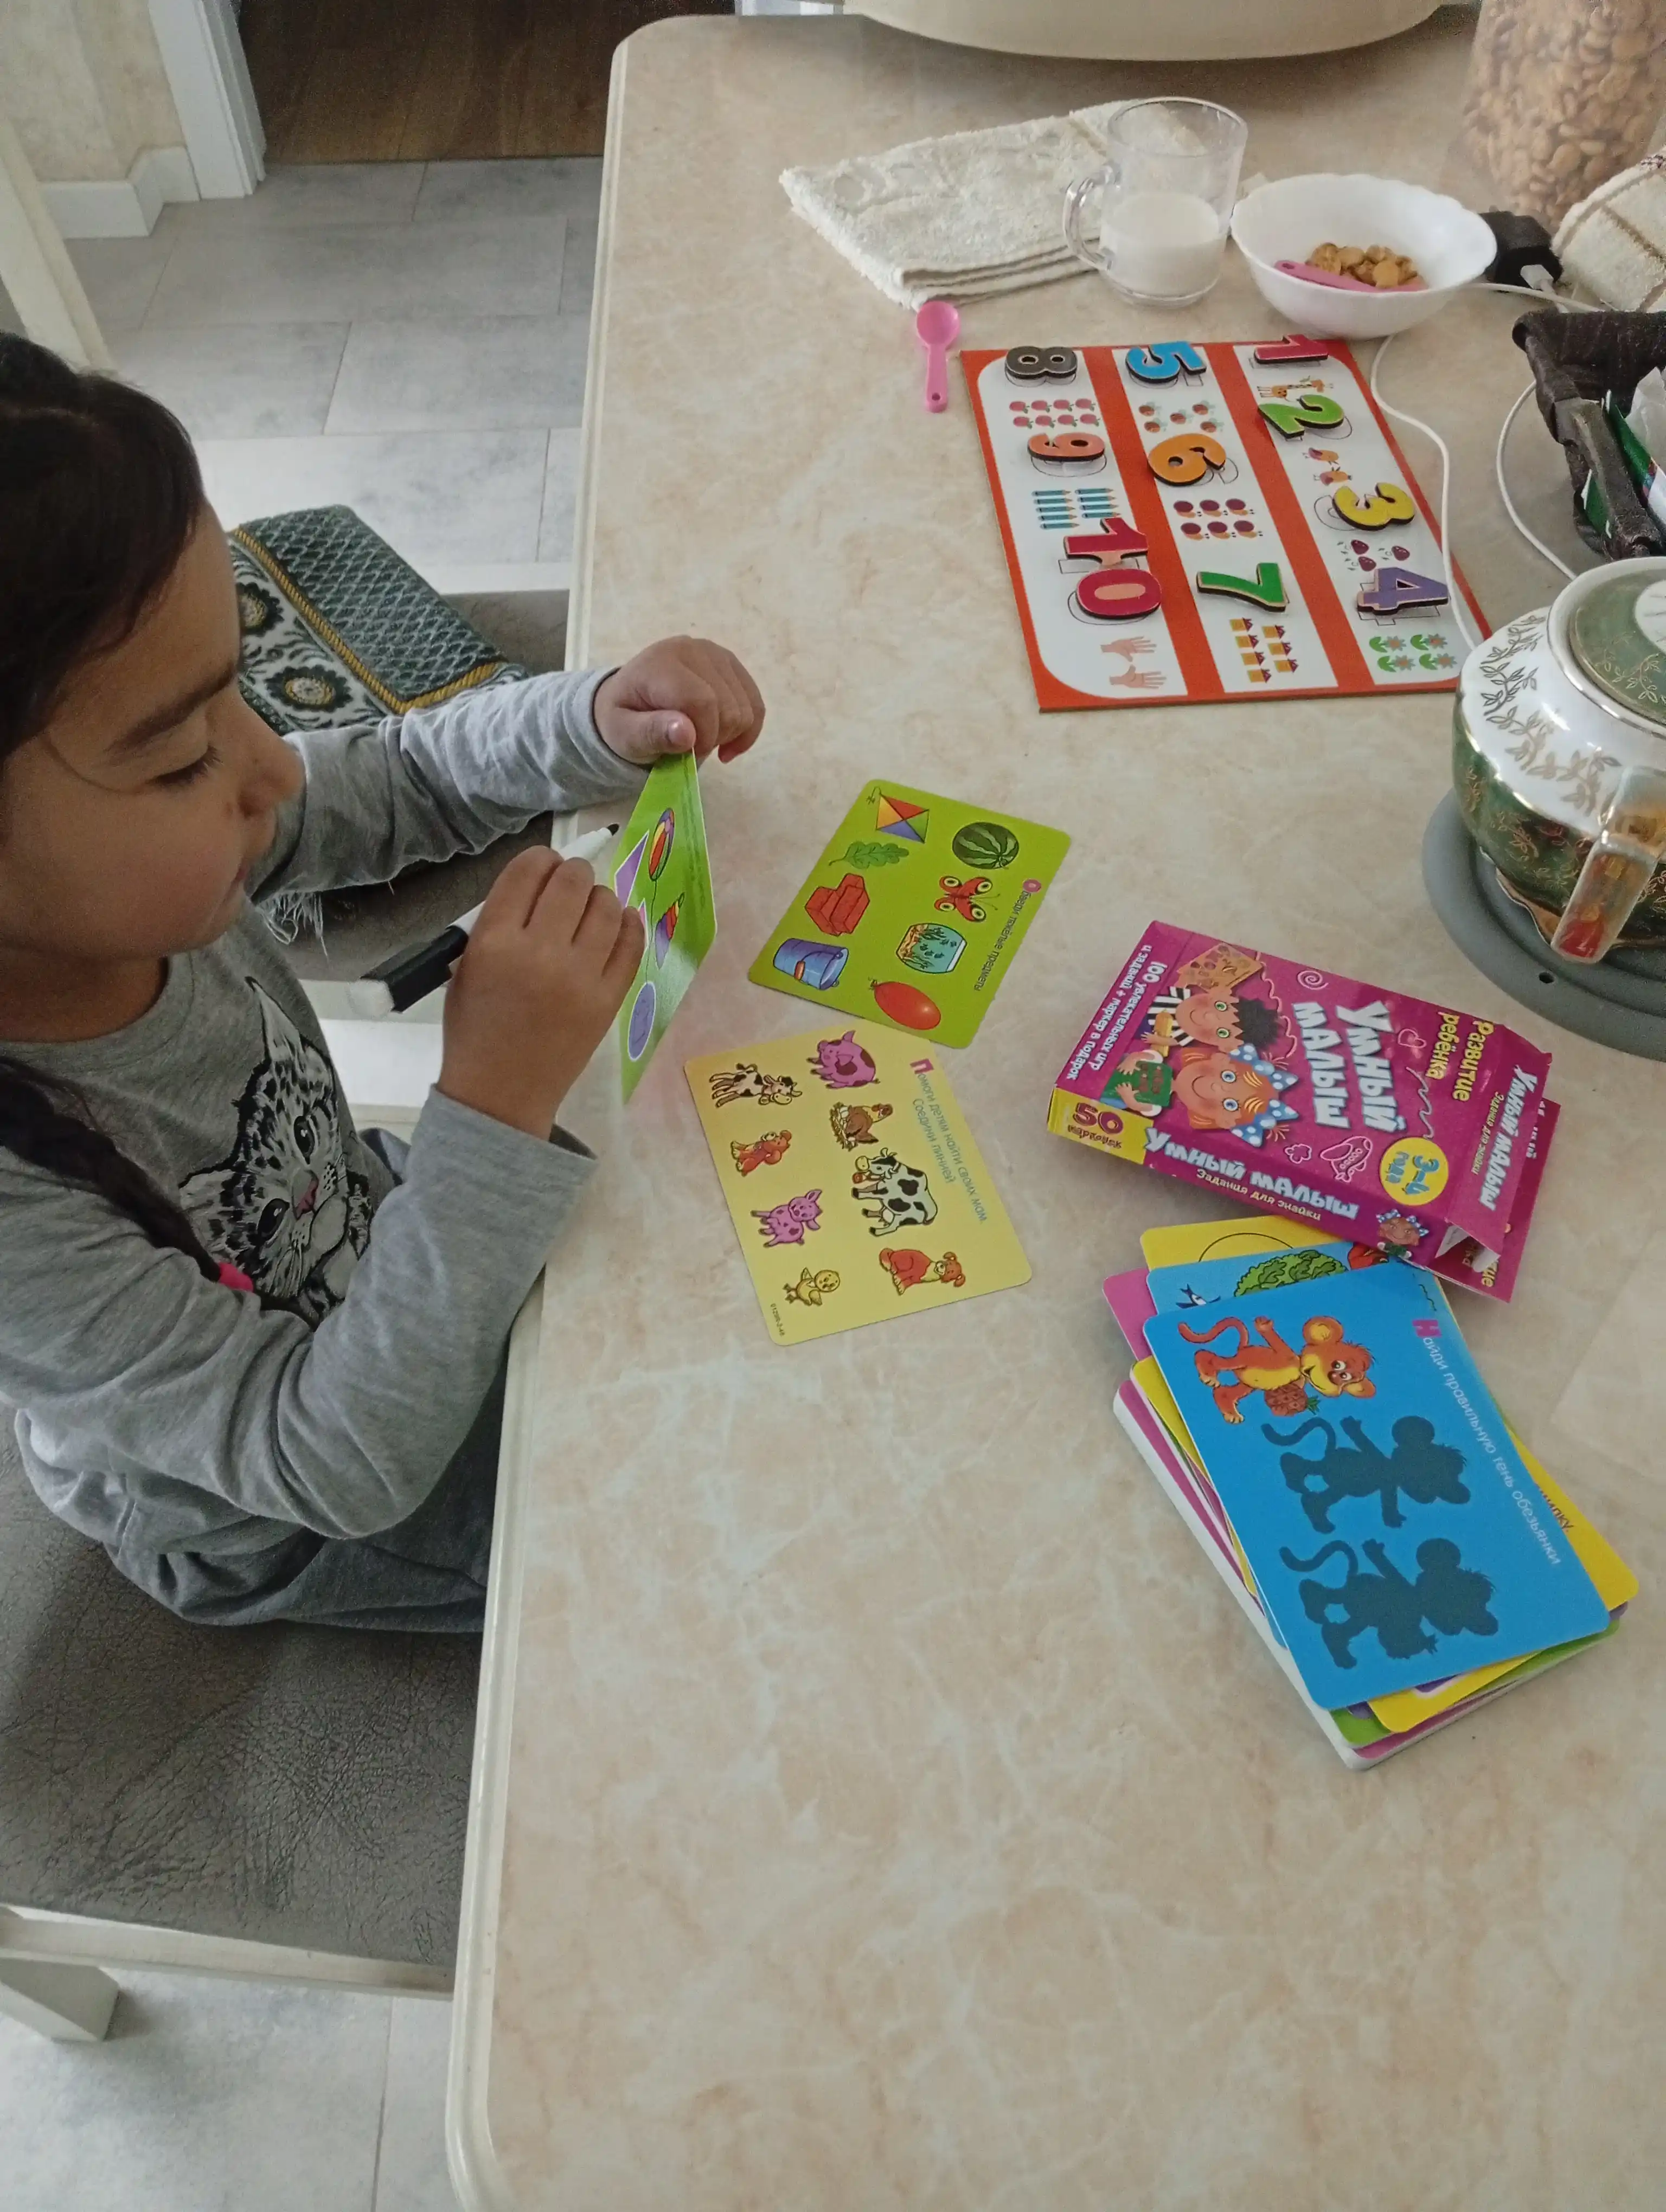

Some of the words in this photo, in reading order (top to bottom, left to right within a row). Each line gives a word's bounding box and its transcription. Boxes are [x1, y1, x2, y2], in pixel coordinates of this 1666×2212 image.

[1004, 345, 1078, 381] 8
[1125, 339, 1207, 384] 5
[1253, 333, 1329, 364] 1
[1258, 394, 1344, 439] 2
[1027, 432, 1106, 462] 9
[1146, 432, 1227, 486] 6
[1332, 482, 1415, 531] 3
[1196, 562, 1287, 612] 7
[1356, 567, 1451, 615] 4
[1013, 878, 1041, 915] Обведи
[974, 951, 999, 991] предметы
[1119, 953, 1148, 989] заданий
[1142, 961, 1167, 983] 100
[1093, 998, 1121, 1032] маркер
[1101, 982, 1147, 1052] увлекательных
[1067, 1041, 1095, 1081] подарок
[1088, 1052, 1107, 1070] игр
[1425, 1011, 1460, 1080] ребёнка
[1452, 1019, 1494, 1102] Развитие
[910, 1058, 935, 1102] Помоги
[928, 1103, 949, 1132] детям
[945, 1133, 963, 1165] найти
[958, 1167, 977, 1195] своих
[1073, 1102, 1124, 1135] 50
[1489, 1091, 1504, 1127] Задания
[913, 1098, 937, 1142] Соедини
[932, 1144, 956, 1184] линией
[1067, 1124, 1123, 1149] карточек
[1482, 1125, 1491, 1145] для
[1197, 1167, 1248, 1194] Задания
[1250, 1190, 1275, 1206] для
[1277, 1198, 1322, 1221] знайки
[1412, 1319, 1448, 1371] Найди
[1443, 1373, 1497, 1454] правильную
[1492, 1456, 1514, 1488] тень
[1512, 1491, 1562, 1565] обезьянки
